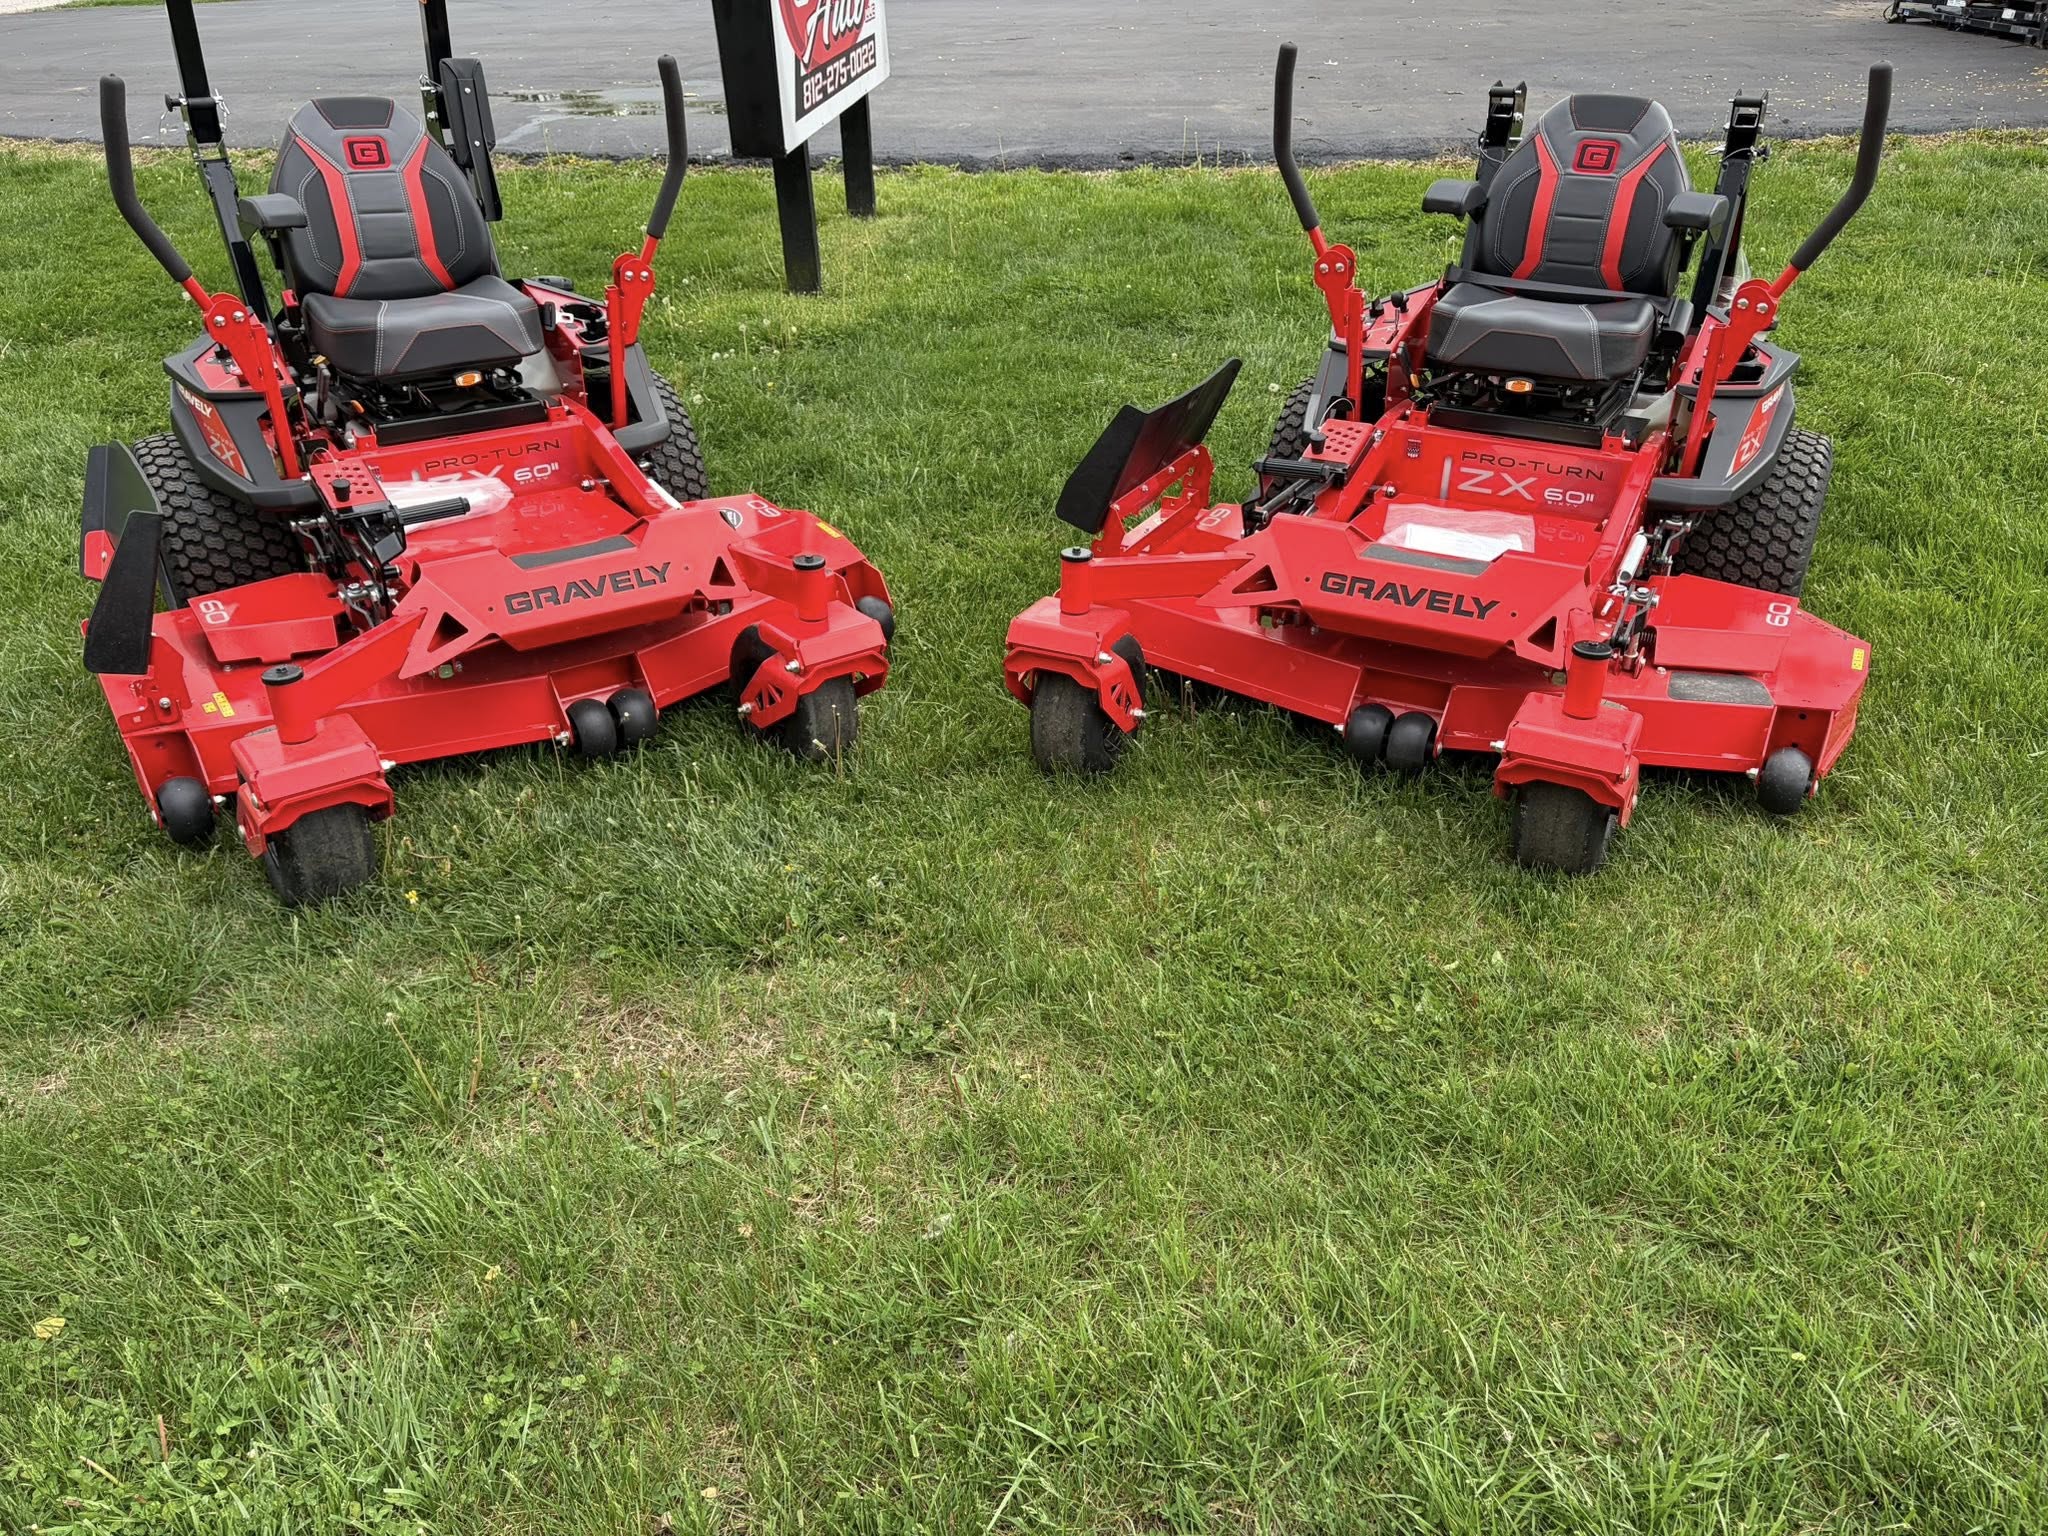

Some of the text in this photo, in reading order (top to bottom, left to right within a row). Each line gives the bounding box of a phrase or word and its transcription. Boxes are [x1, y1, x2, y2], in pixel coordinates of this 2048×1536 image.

[803, 40, 875, 110] 812-275-0022
[209, 435, 236, 468] ZX
[425, 439, 561, 472] PRO-TURN
[1462, 451, 1604, 481] PRO-TURN
[1457, 466, 1538, 501] ZX
[1200, 508, 1231, 527] 60
[504, 562, 671, 615] GRAVELY
[1320, 571, 1501, 620] GRAVELY
[199, 600, 230, 625] 60
[1765, 602, 1792, 627] 60
